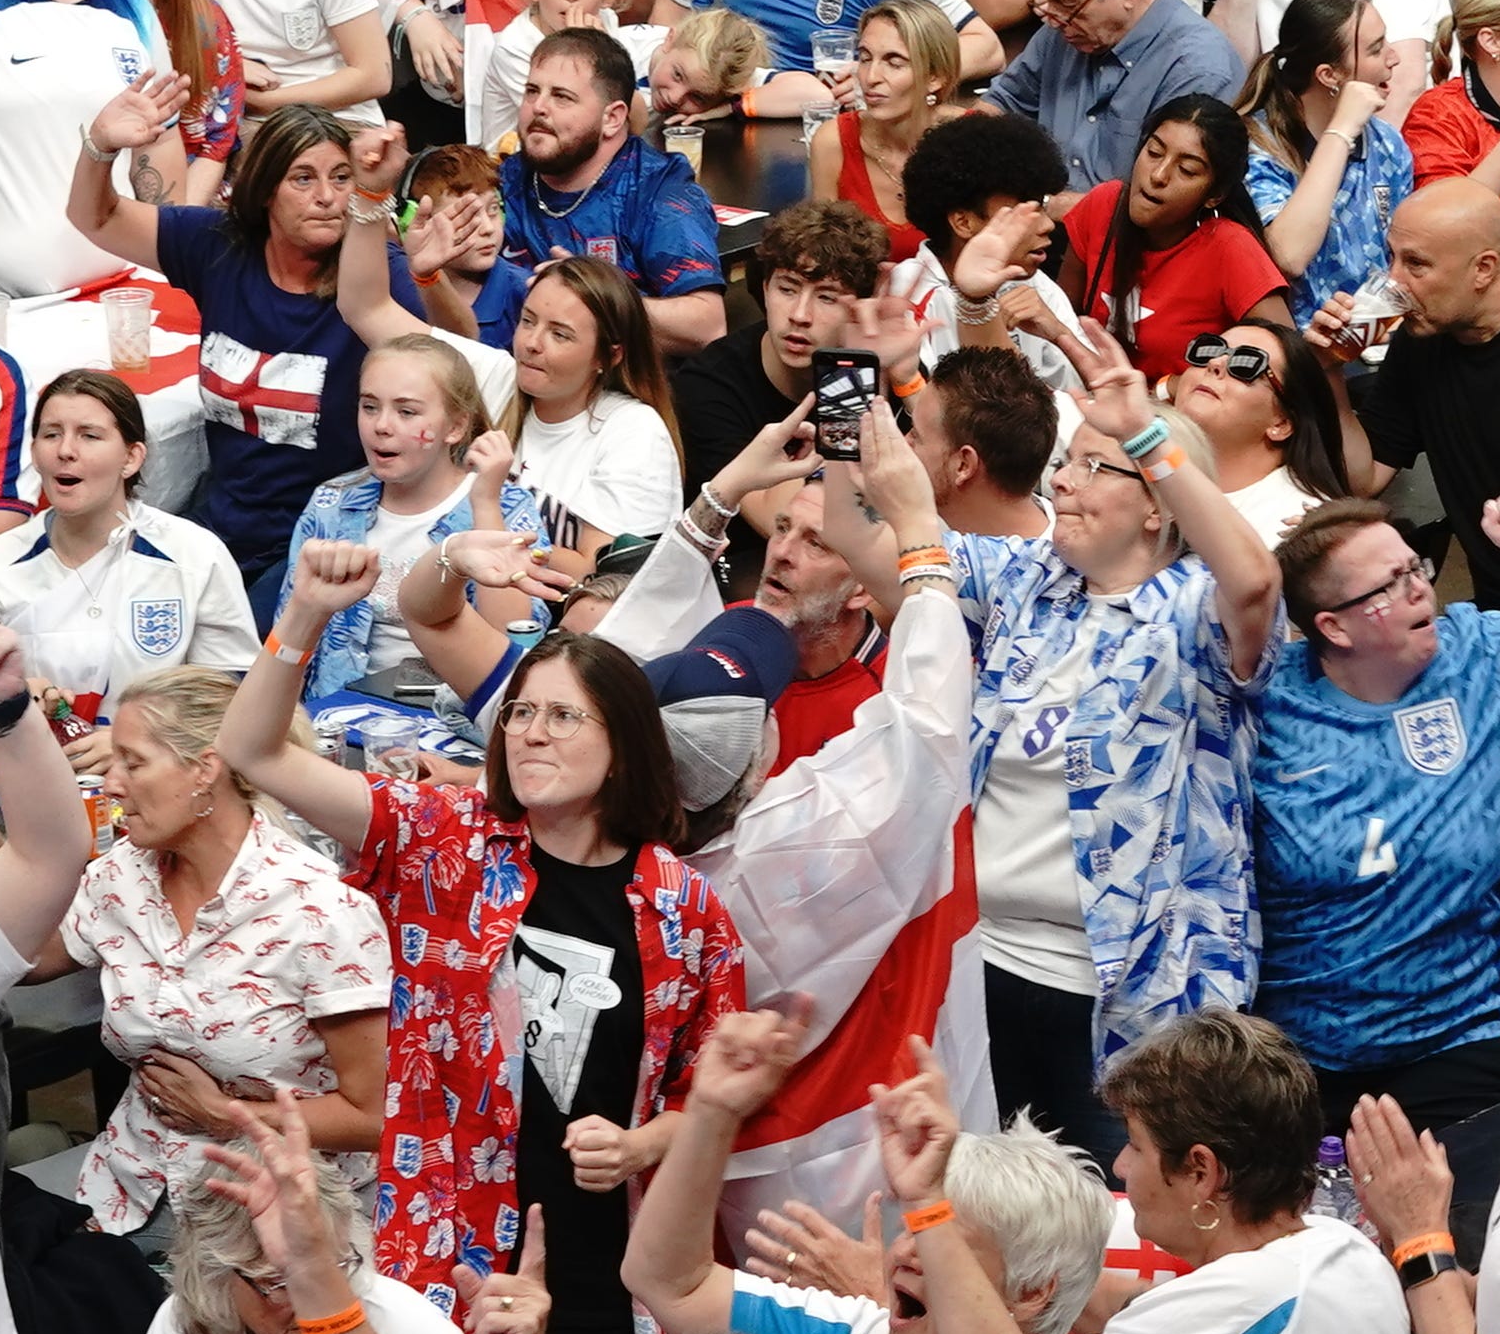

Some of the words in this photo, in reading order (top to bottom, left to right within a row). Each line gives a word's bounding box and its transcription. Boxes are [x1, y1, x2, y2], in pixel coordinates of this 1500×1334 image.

[1022, 706, 1070, 758] 8
[1357, 818, 1398, 877] 4
[524, 1019, 542, 1049] 8
